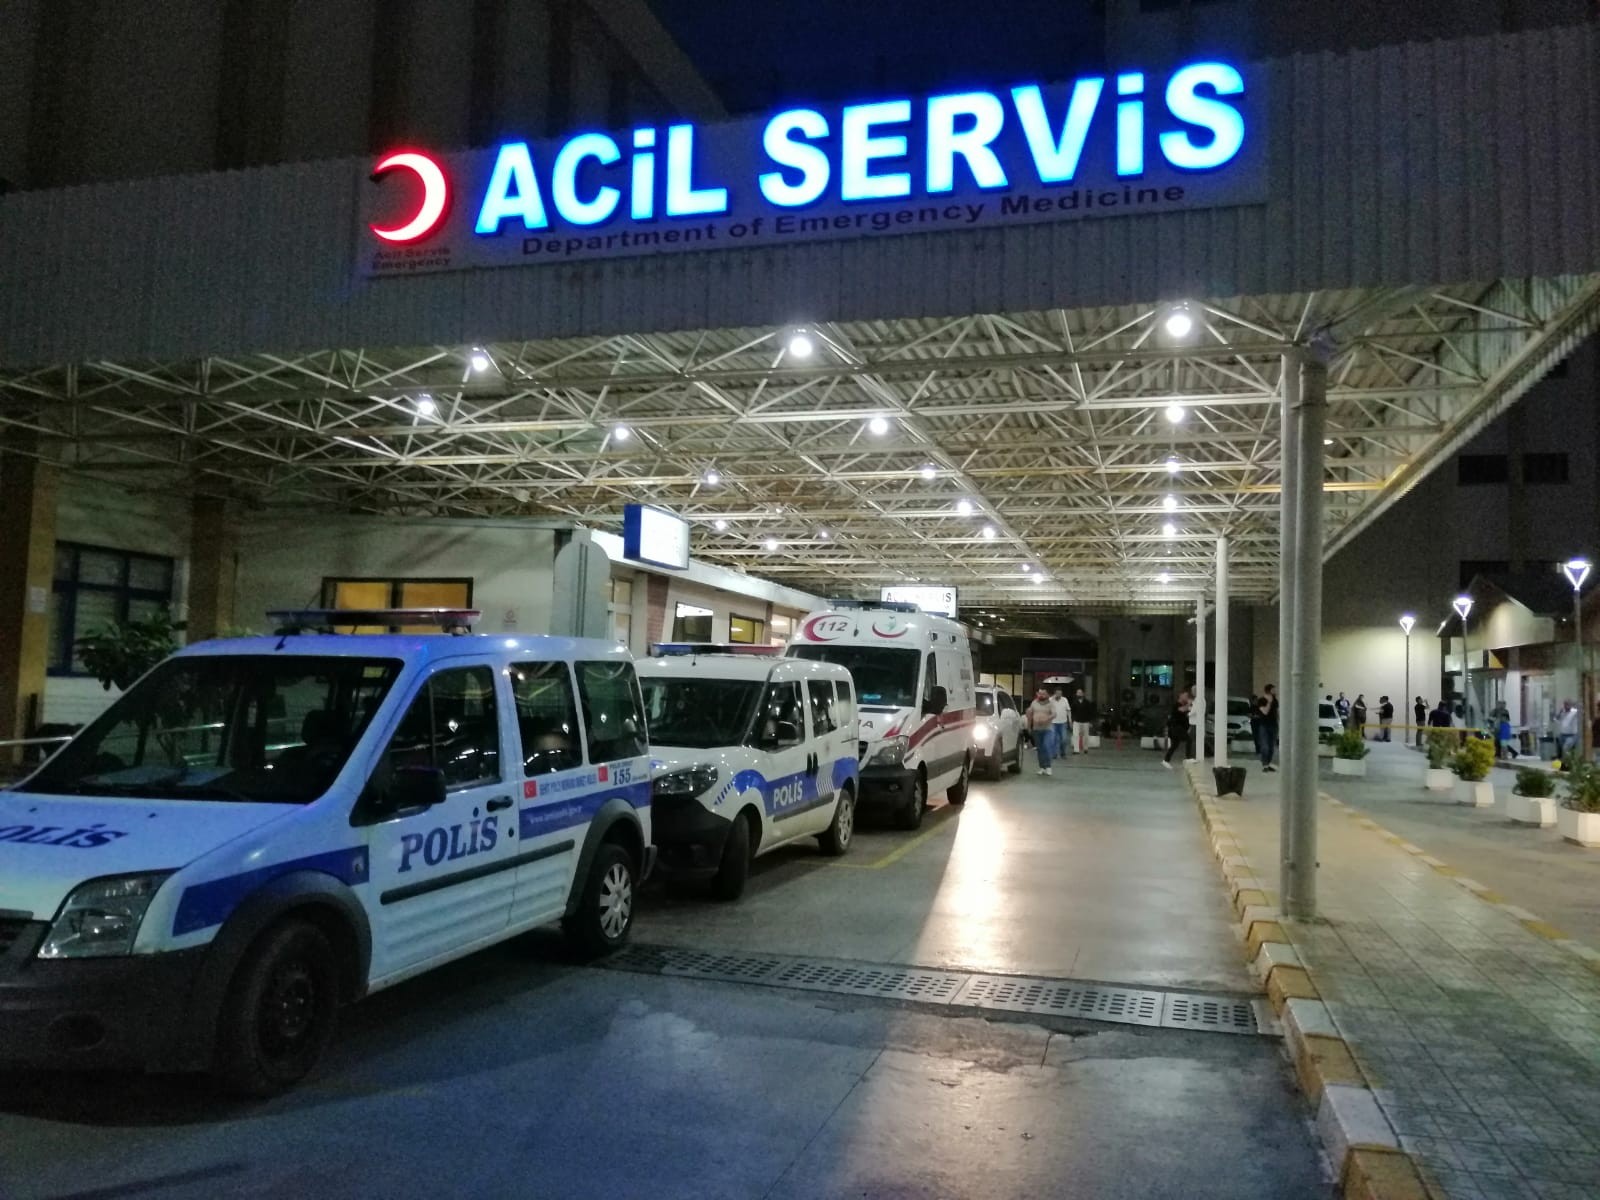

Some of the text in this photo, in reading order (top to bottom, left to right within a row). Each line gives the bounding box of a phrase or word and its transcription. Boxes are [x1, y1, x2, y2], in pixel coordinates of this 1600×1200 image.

[523, 184, 1185, 258] Department of Emergency Medicine
[817, 620, 848, 632] 112
[612, 767, 632, 787] 155
[773, 775, 804, 810] POLİS
[397, 806, 498, 873] POLİS
